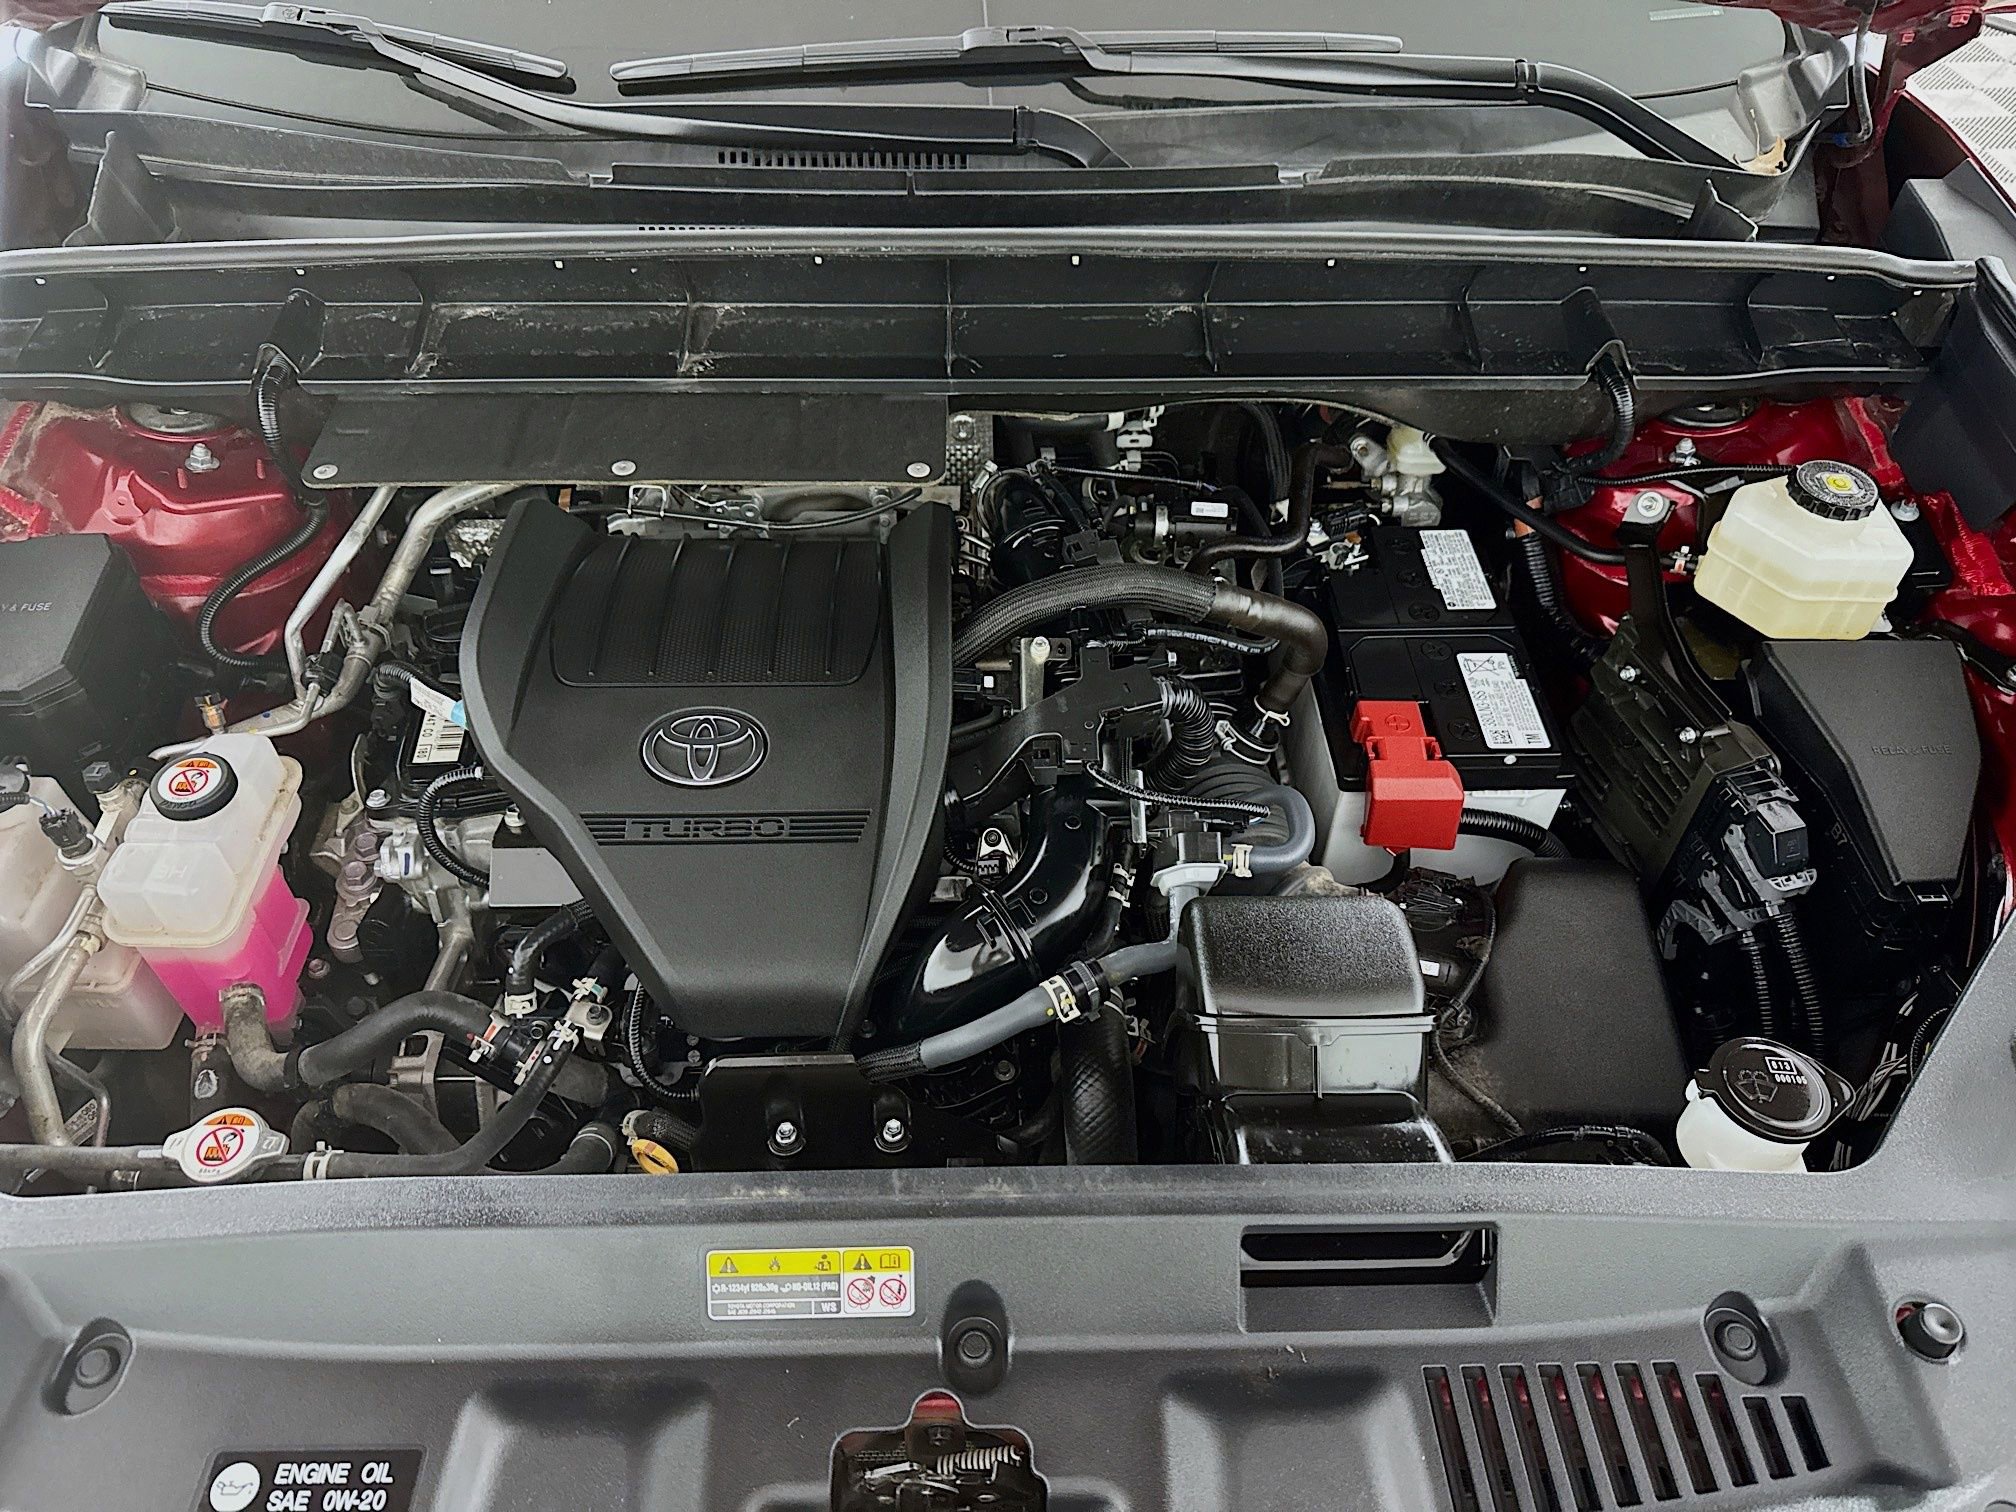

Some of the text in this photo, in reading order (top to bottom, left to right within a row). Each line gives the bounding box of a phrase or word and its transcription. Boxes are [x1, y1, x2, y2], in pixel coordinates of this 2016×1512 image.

[20, 602, 53, 611] FUSE
[1871, 745, 1908, 755] RELAY
[1921, 744, 1952, 755] FUSE
[631, 817, 785, 838] TURBO
[820, 1302, 837, 1313] WS
[273, 1462, 394, 1485] ENGINE OIL
[266, 1489, 387, 1512] SAE 0W-20
